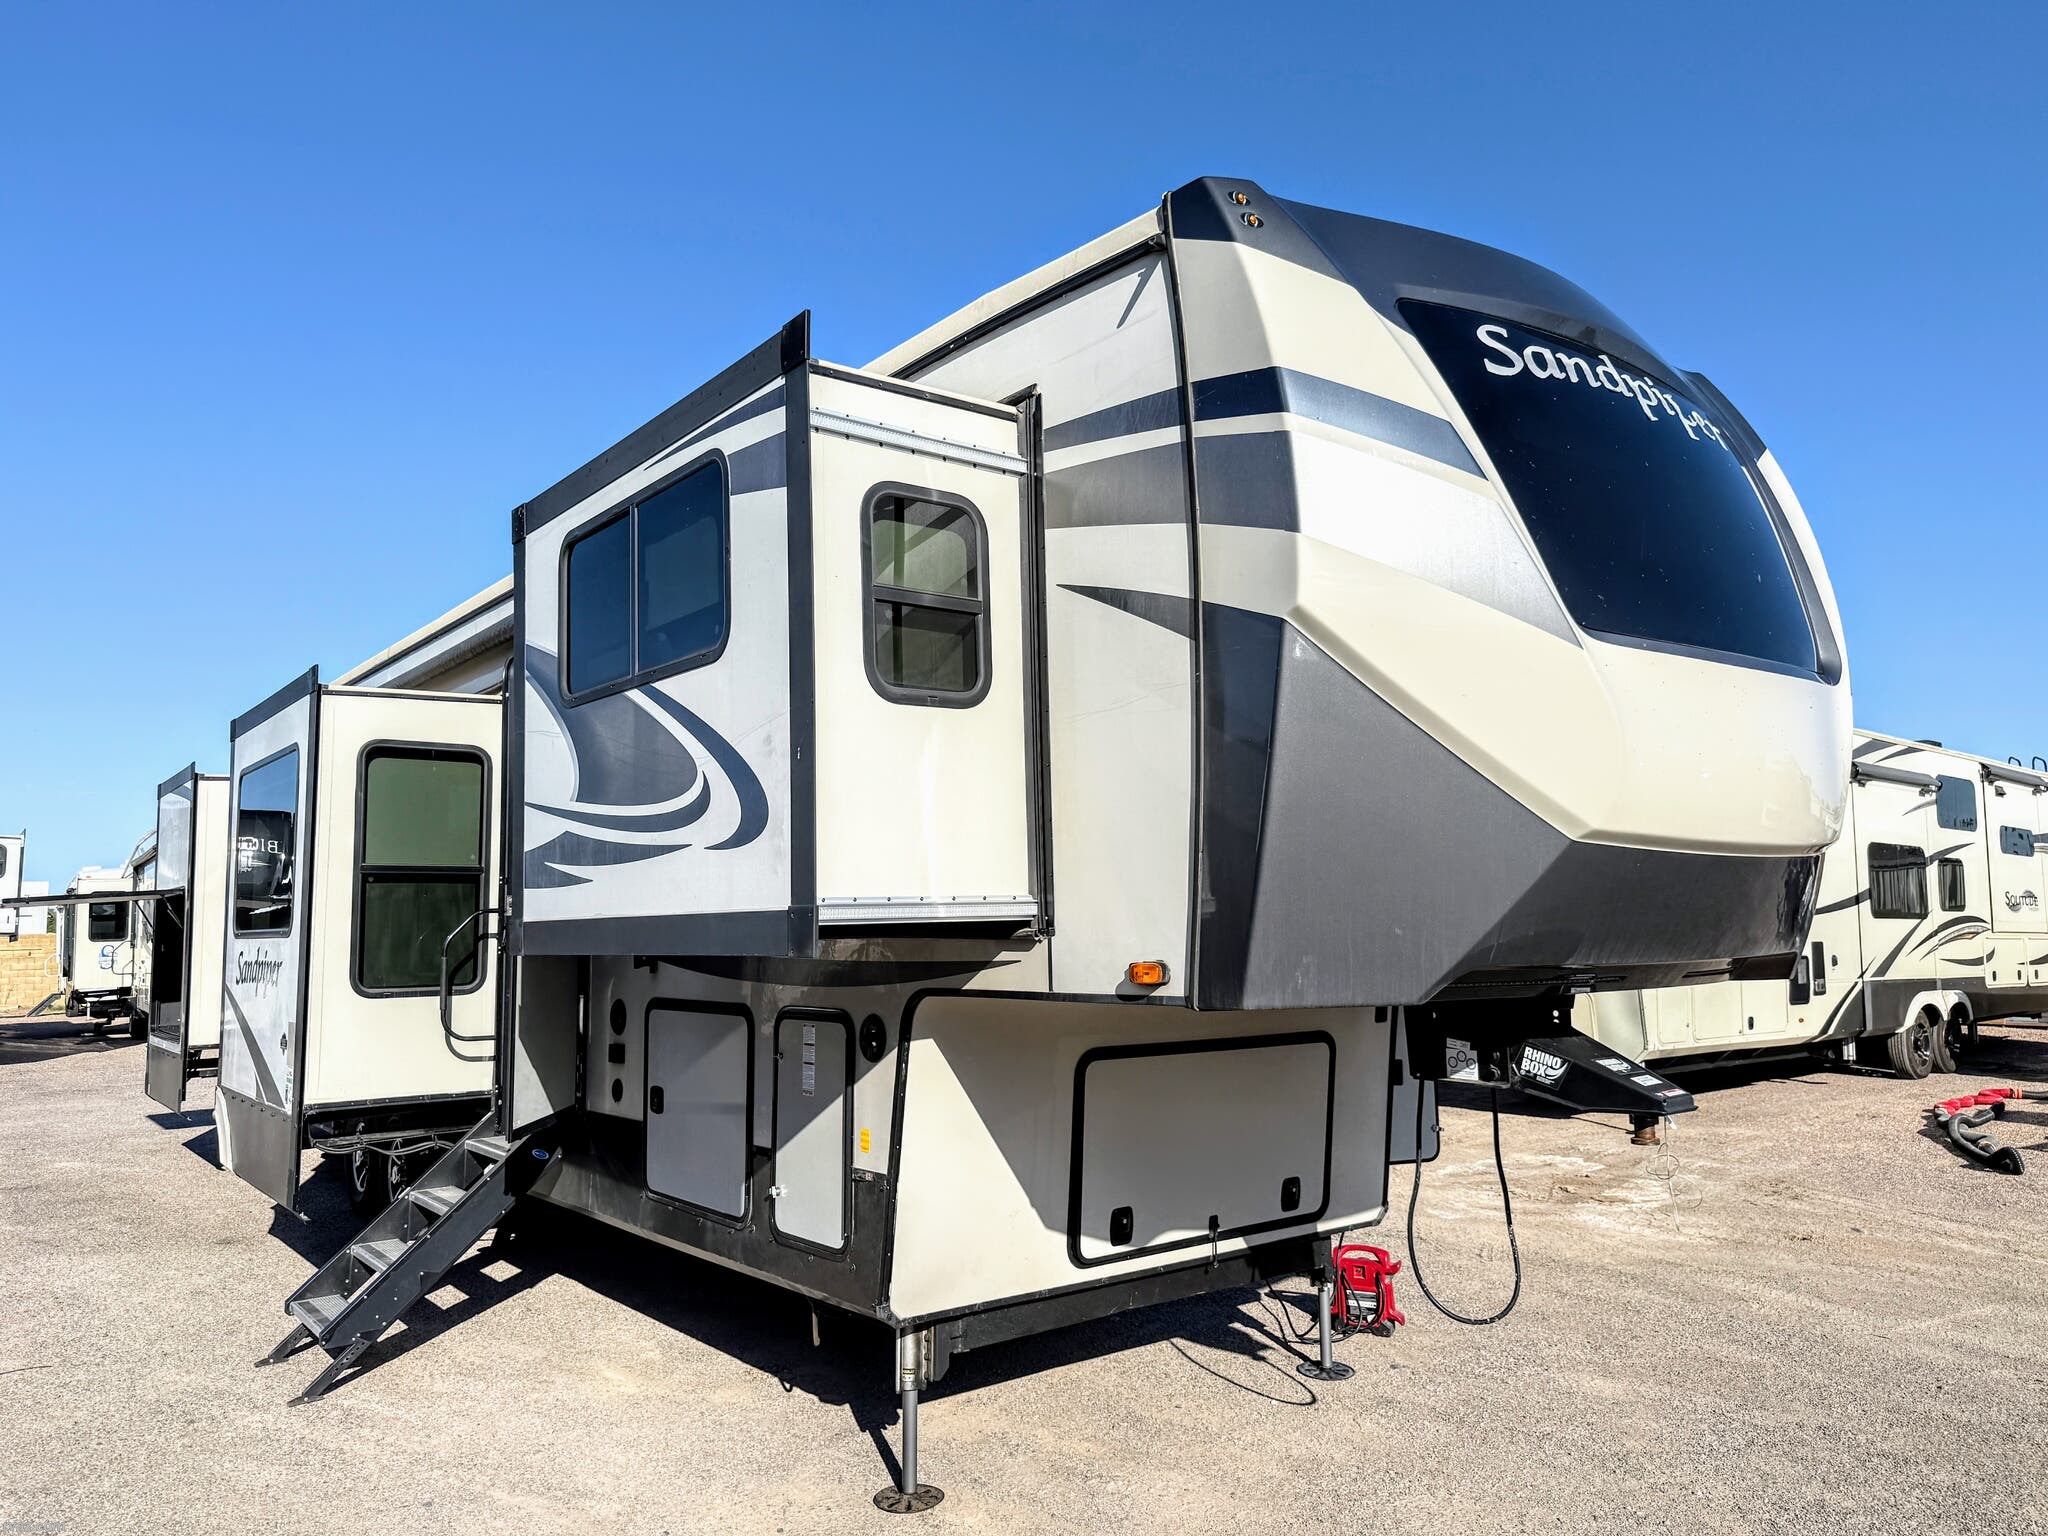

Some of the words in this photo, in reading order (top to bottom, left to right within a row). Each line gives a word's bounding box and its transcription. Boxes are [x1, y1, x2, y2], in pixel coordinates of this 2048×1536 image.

[1476, 324, 1728, 450] Sandpiper
[235, 946, 283, 999] Sandpiper
[1520, 1057, 1548, 1077] BOX
[1523, 1046, 1562, 1070] RHINO
